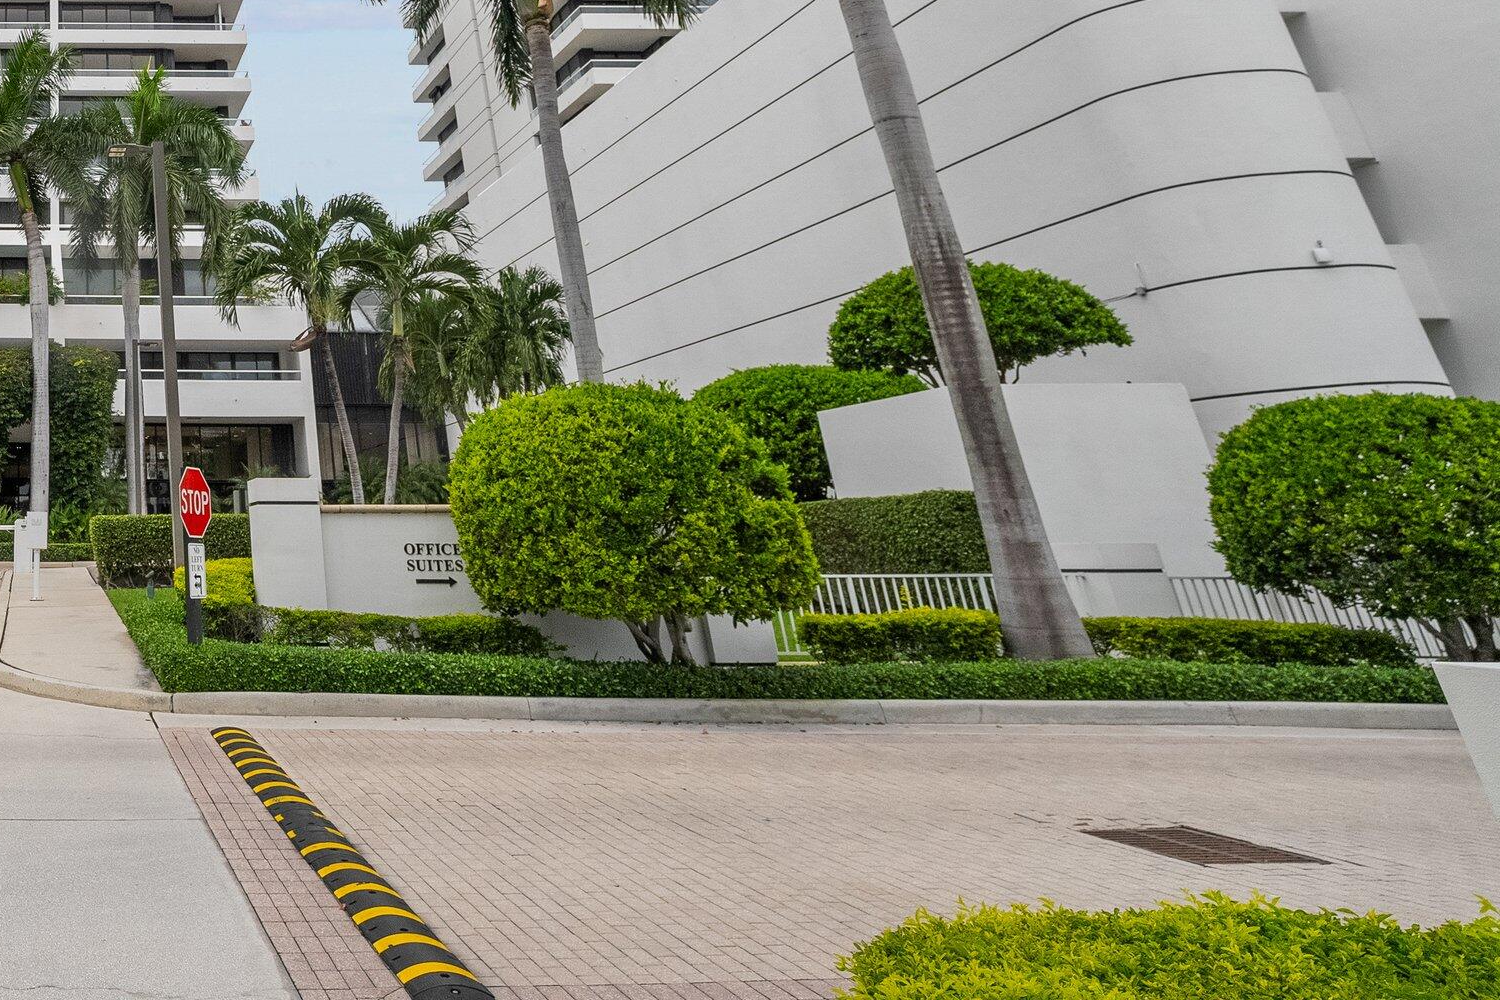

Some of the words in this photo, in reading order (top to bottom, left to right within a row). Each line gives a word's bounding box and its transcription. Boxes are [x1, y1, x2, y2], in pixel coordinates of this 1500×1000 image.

[181, 488, 209, 515] STOP
[403, 542, 461, 556] OFFICE
[191, 555, 202, 563] LEFT
[406, 559, 464, 572] SUITES
[191, 564, 204, 572] TURN
